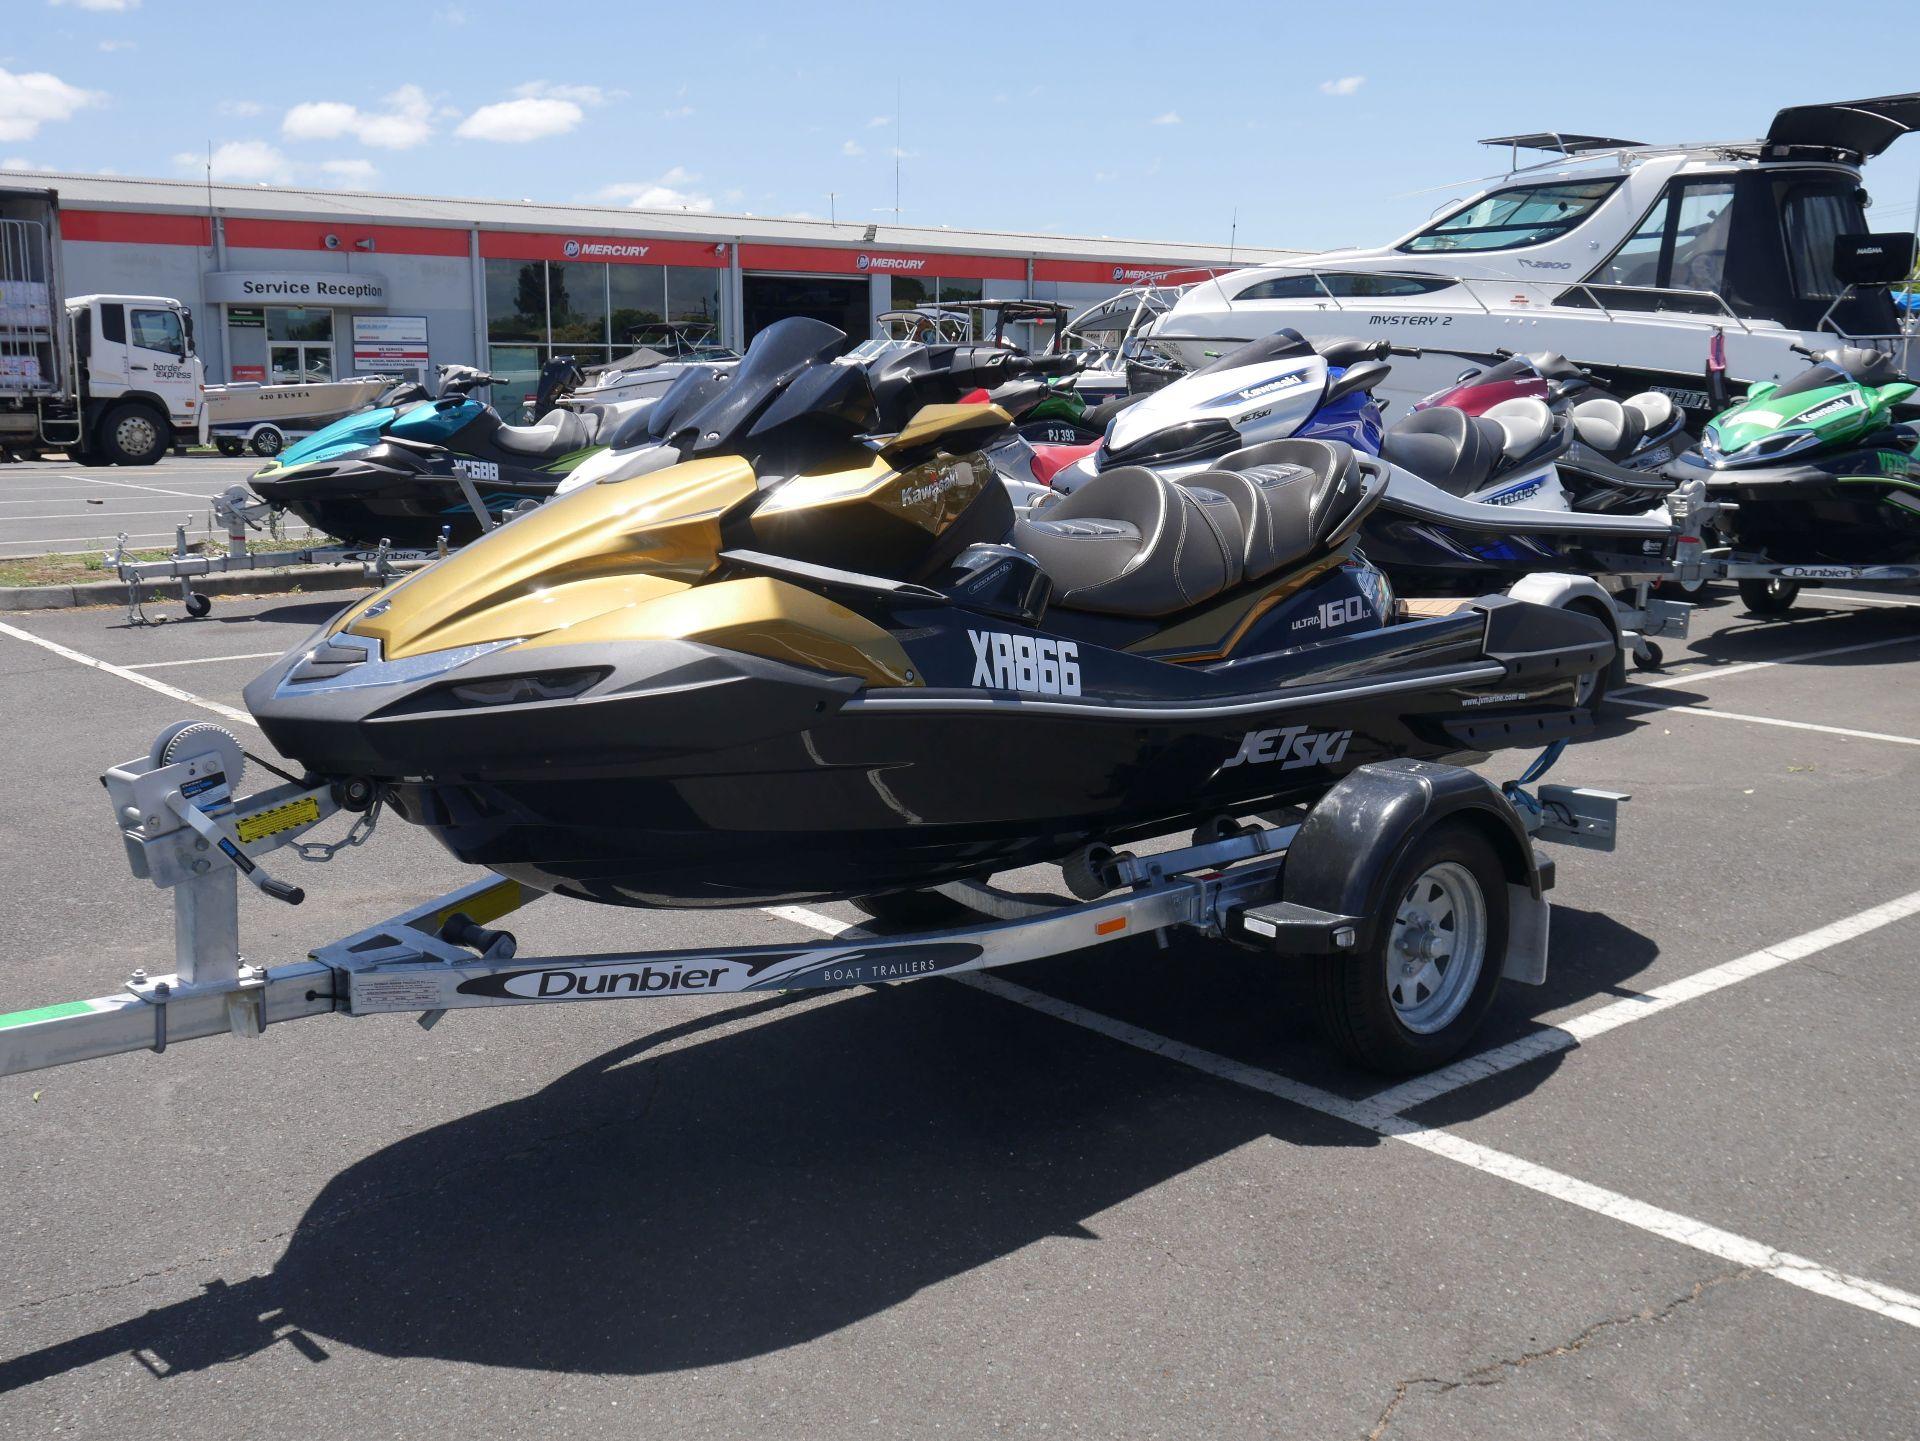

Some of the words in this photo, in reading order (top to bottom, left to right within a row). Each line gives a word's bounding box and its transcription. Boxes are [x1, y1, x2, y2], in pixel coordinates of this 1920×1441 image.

[582, 243, 650, 258] MERCURY
[871, 257, 926, 271] MERCURY
[1125, 268, 1169, 281] MERCURY
[243, 279, 311, 296] Service
[316, 281, 383, 299] Reception
[1369, 315, 1438, 326] MYSTERY
[1442, 316, 1453, 326] 2
[153, 363, 183, 372] border
[155, 371, 192, 380] express
[1239, 375, 1303, 399] Kawasaki
[1797, 399, 1851, 424] Kawasaki
[1048, 429, 1059, 442] PJ
[1061, 429, 1075, 442] 393
[900, 469, 959, 507] Kawasaki
[365, 551, 420, 562] Dnbier
[1793, 567, 1850, 578] Dunbier
[1318, 595, 1363, 630] 160
[823, 967, 863, 982] BOAT
[873, 959, 937, 978] TRAILERS
[537, 963, 731, 998] Dunbier
